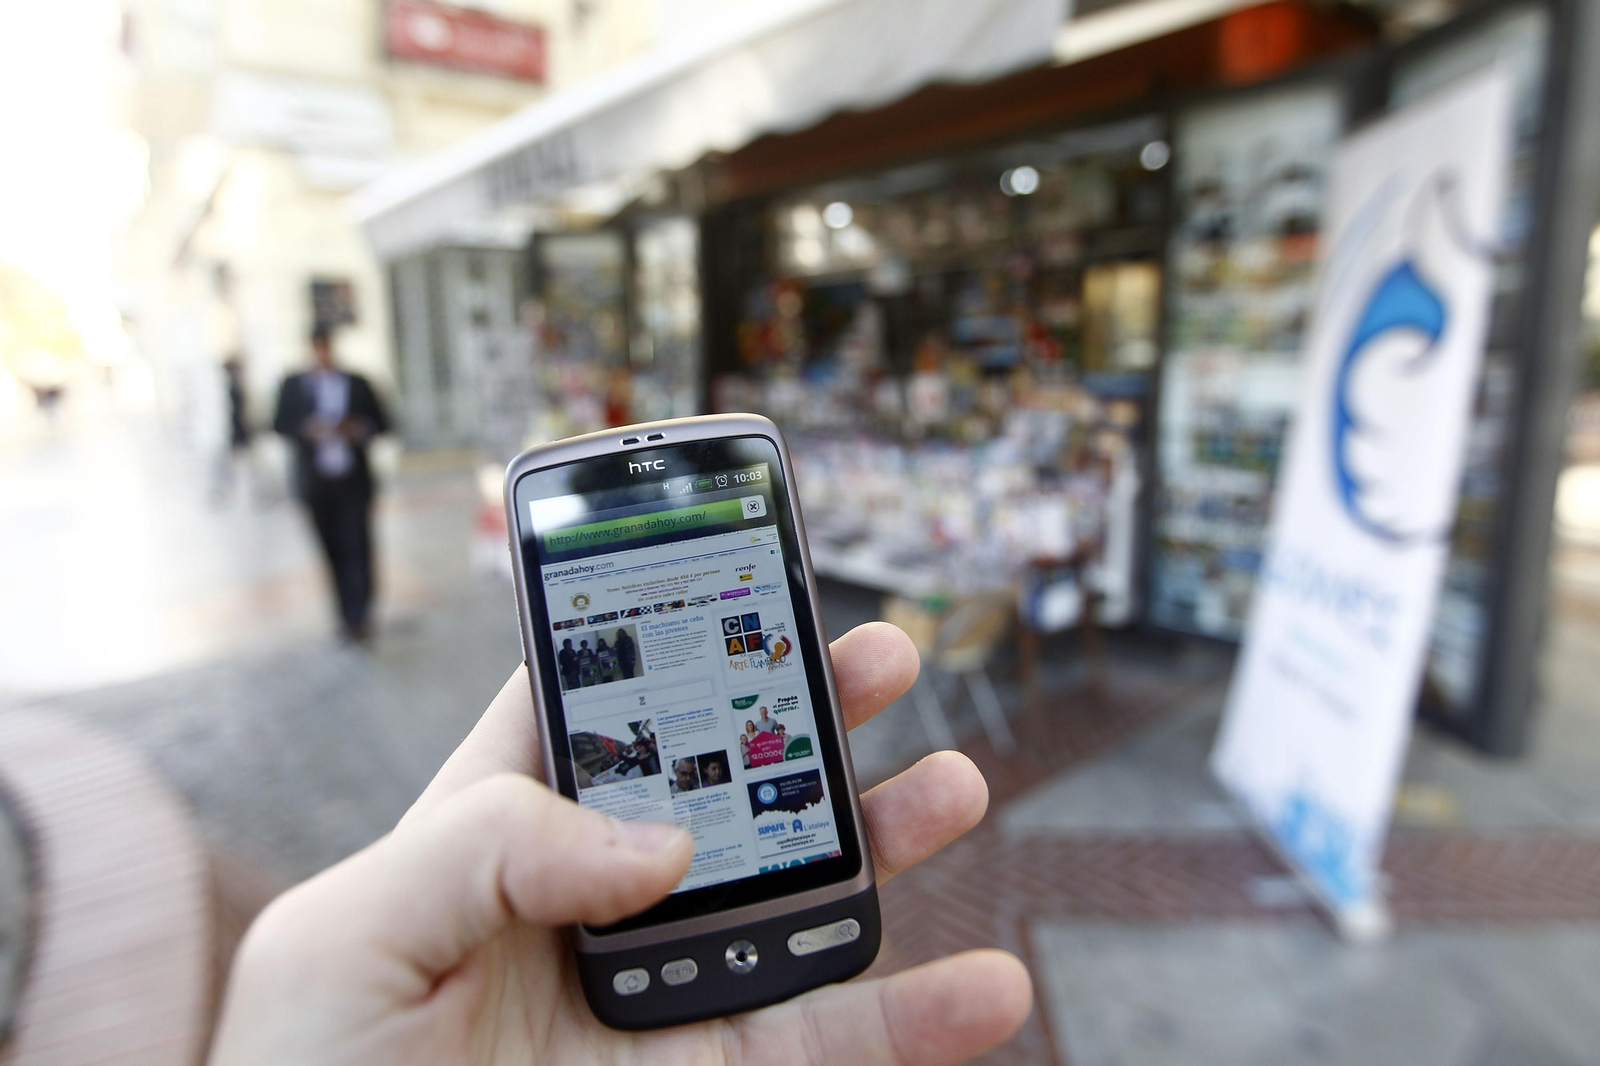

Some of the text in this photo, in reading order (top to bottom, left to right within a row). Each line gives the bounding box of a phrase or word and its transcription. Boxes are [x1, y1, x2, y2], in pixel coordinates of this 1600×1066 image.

[733, 471, 763, 484] 10:03
[549, 511, 706, 547] http://www.granadahoy.com/
[543, 561, 615, 582] granadahoy.com
[735, 562, 757, 573] renfe
[648, 620, 681, 631] machismo
[689, 615, 704, 623] ceba
[665, 625, 689, 636] jóvenes
[757, 822, 787, 836] SUPAFIL
[804, 820, 830, 832] L'atalaya
